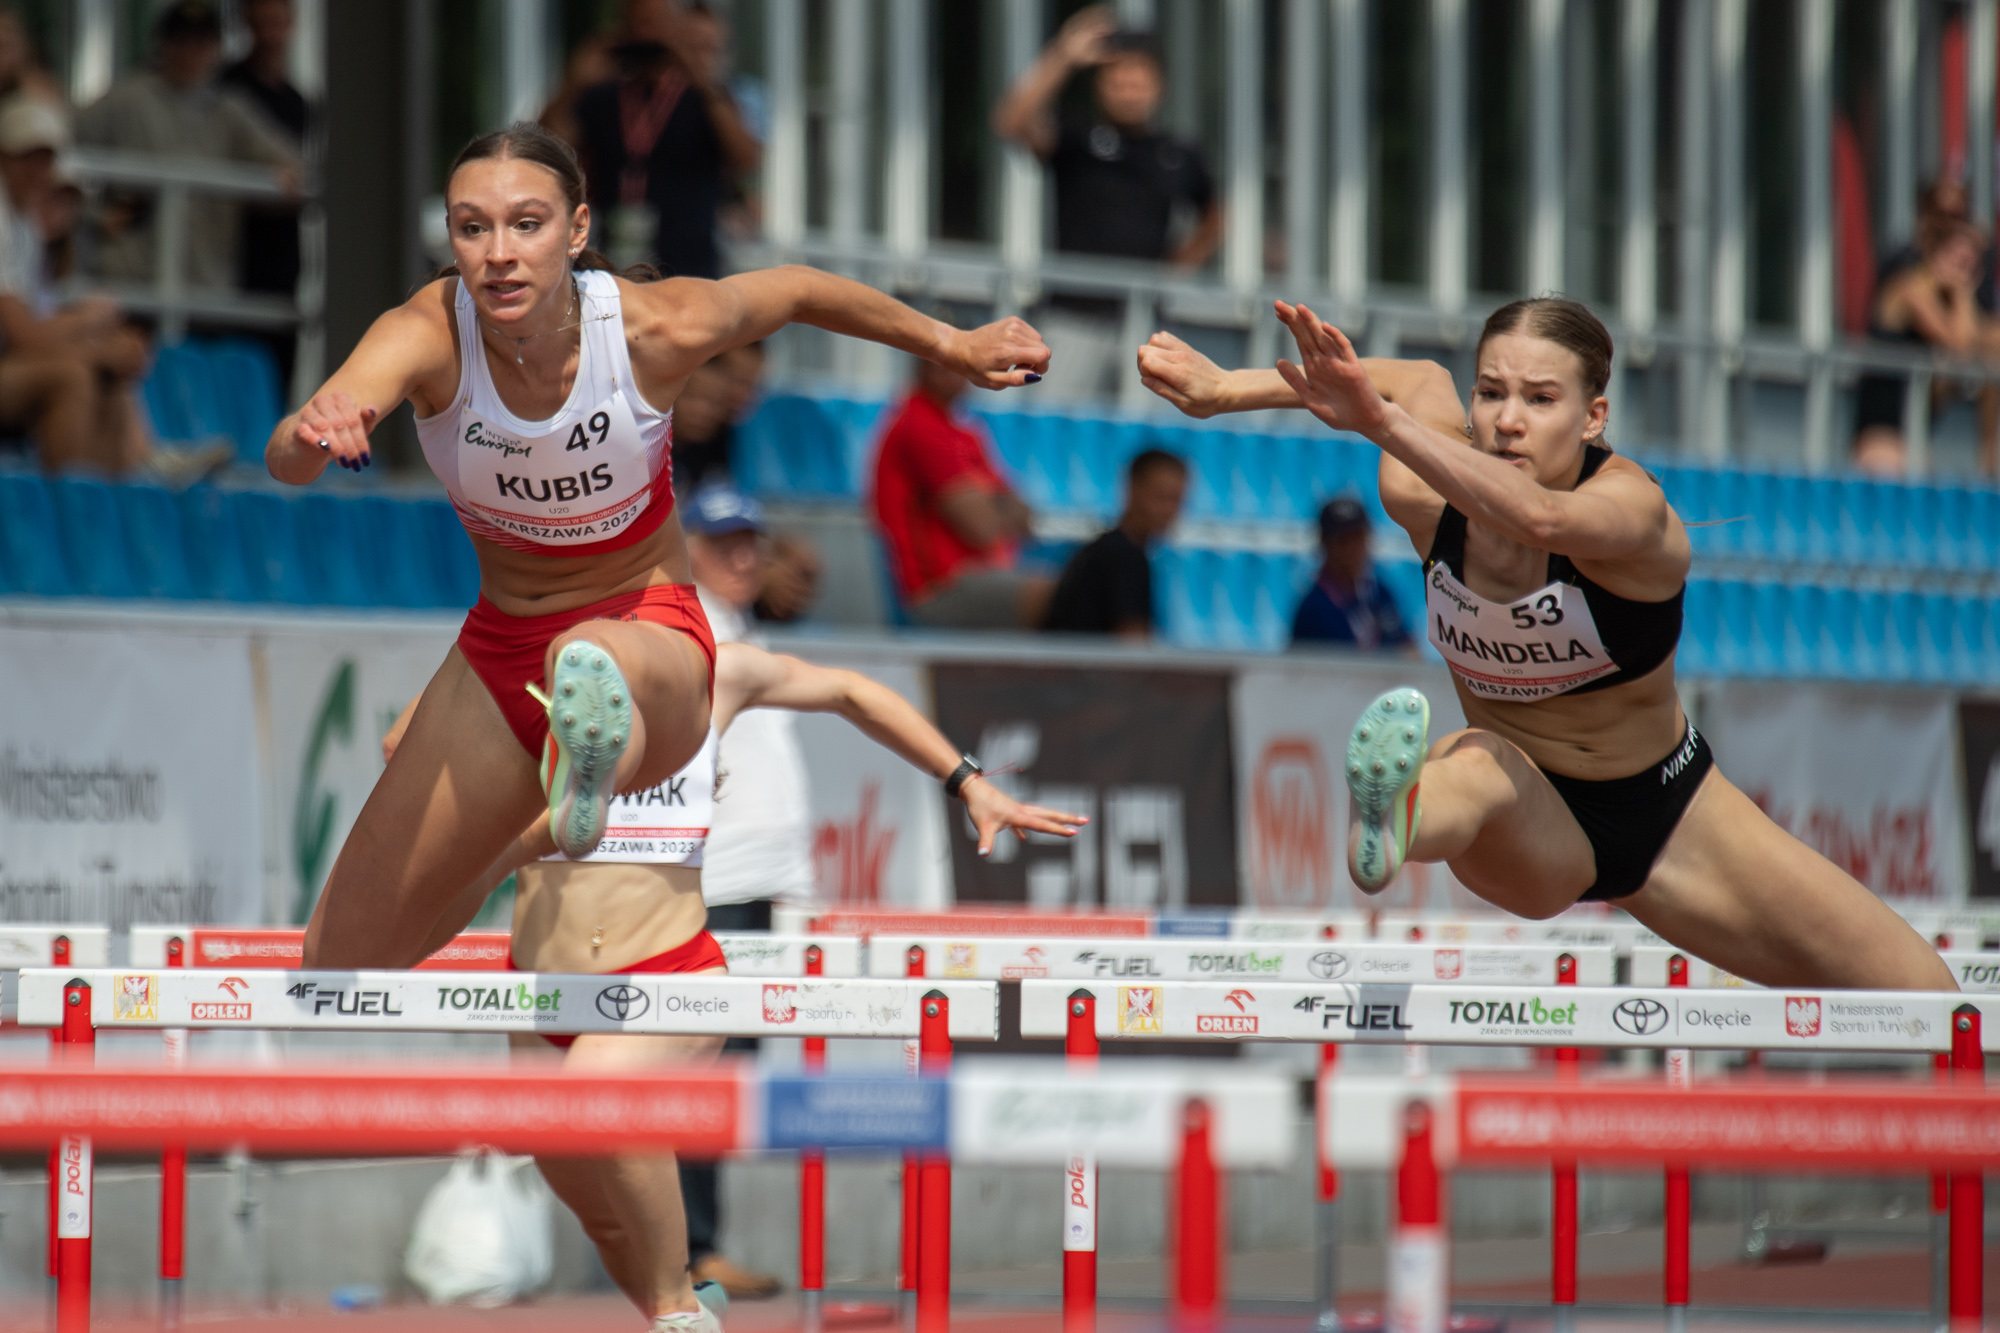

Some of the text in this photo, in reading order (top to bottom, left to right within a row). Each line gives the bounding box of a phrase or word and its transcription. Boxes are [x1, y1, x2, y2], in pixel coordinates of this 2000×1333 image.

[465, 421, 532, 459] Europol
[566, 411, 610, 452] 49
[496, 463, 614, 502] KUBIS
[490, 505, 637, 539] WARSZAWA 2023
[545, 517, 571, 526] POLSKI
[580, 501, 629, 522] WIELOBOJACH
[549, 507, 569, 515] U20
[1432, 570, 1479, 618] Europol
[1511, 594, 1565, 630] 53
[1437, 613, 1594, 664] MANDELA
[1661, 739, 1695, 785] NIKE
[608, 777, 687, 807] WAK
[594, 841, 695, 853] SZAWA 2023
[1095, 957, 1162, 977] FUEL
[1188, 951, 1284, 972] TOTALbet
[1961, 966, 2000, 984] TOT
[286, 983, 403, 1016] 4F FUEL
[437, 983, 562, 1011] TOTALbet
[666, 996, 729, 1016] Okęcie
[194, 1004, 249, 1019] ORLEN
[500, 1014, 558, 1022] BUKMACHERSKIE
[805, 1008, 843, 1021] Sportu
[1293, 996, 1415, 1030] 4F FUEL
[1449, 996, 1578, 1025] TOTALbet
[1686, 1009, 1752, 1030] Okęcie
[1830, 1004, 1904, 1016] Ministerstwo
[1199, 1017, 1256, 1032] ORLEN
[1830, 1020, 1869, 1034] Sportu
